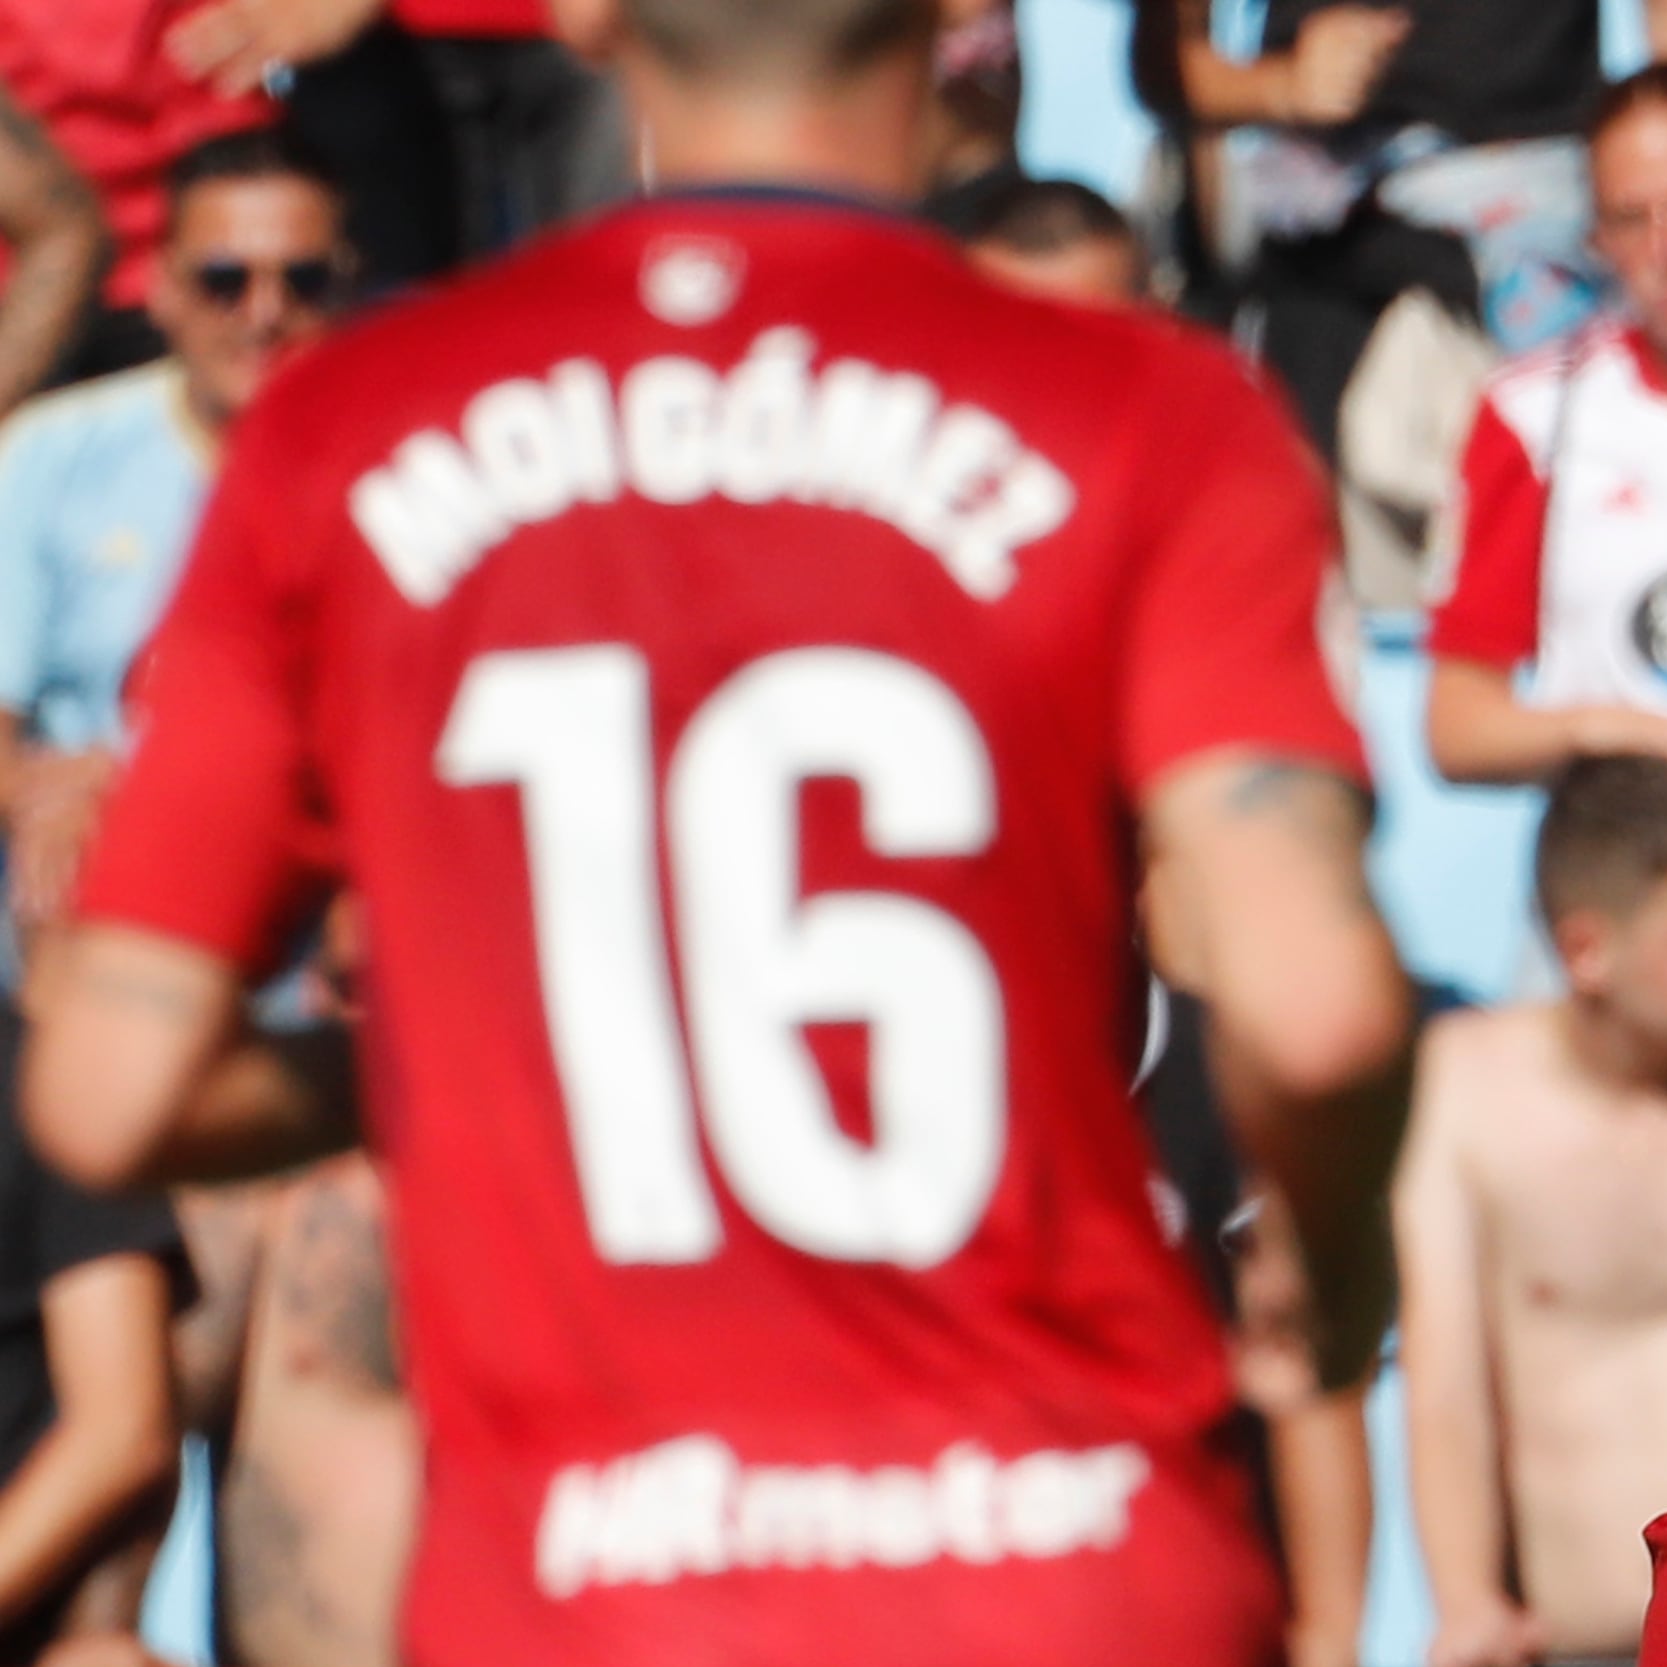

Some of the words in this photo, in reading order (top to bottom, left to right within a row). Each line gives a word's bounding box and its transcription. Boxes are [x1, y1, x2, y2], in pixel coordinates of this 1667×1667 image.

[348, 356, 622, 610] MOI
[618, 324, 1078, 606] GÓMEZ
[433, 640, 1010, 1270] 16
